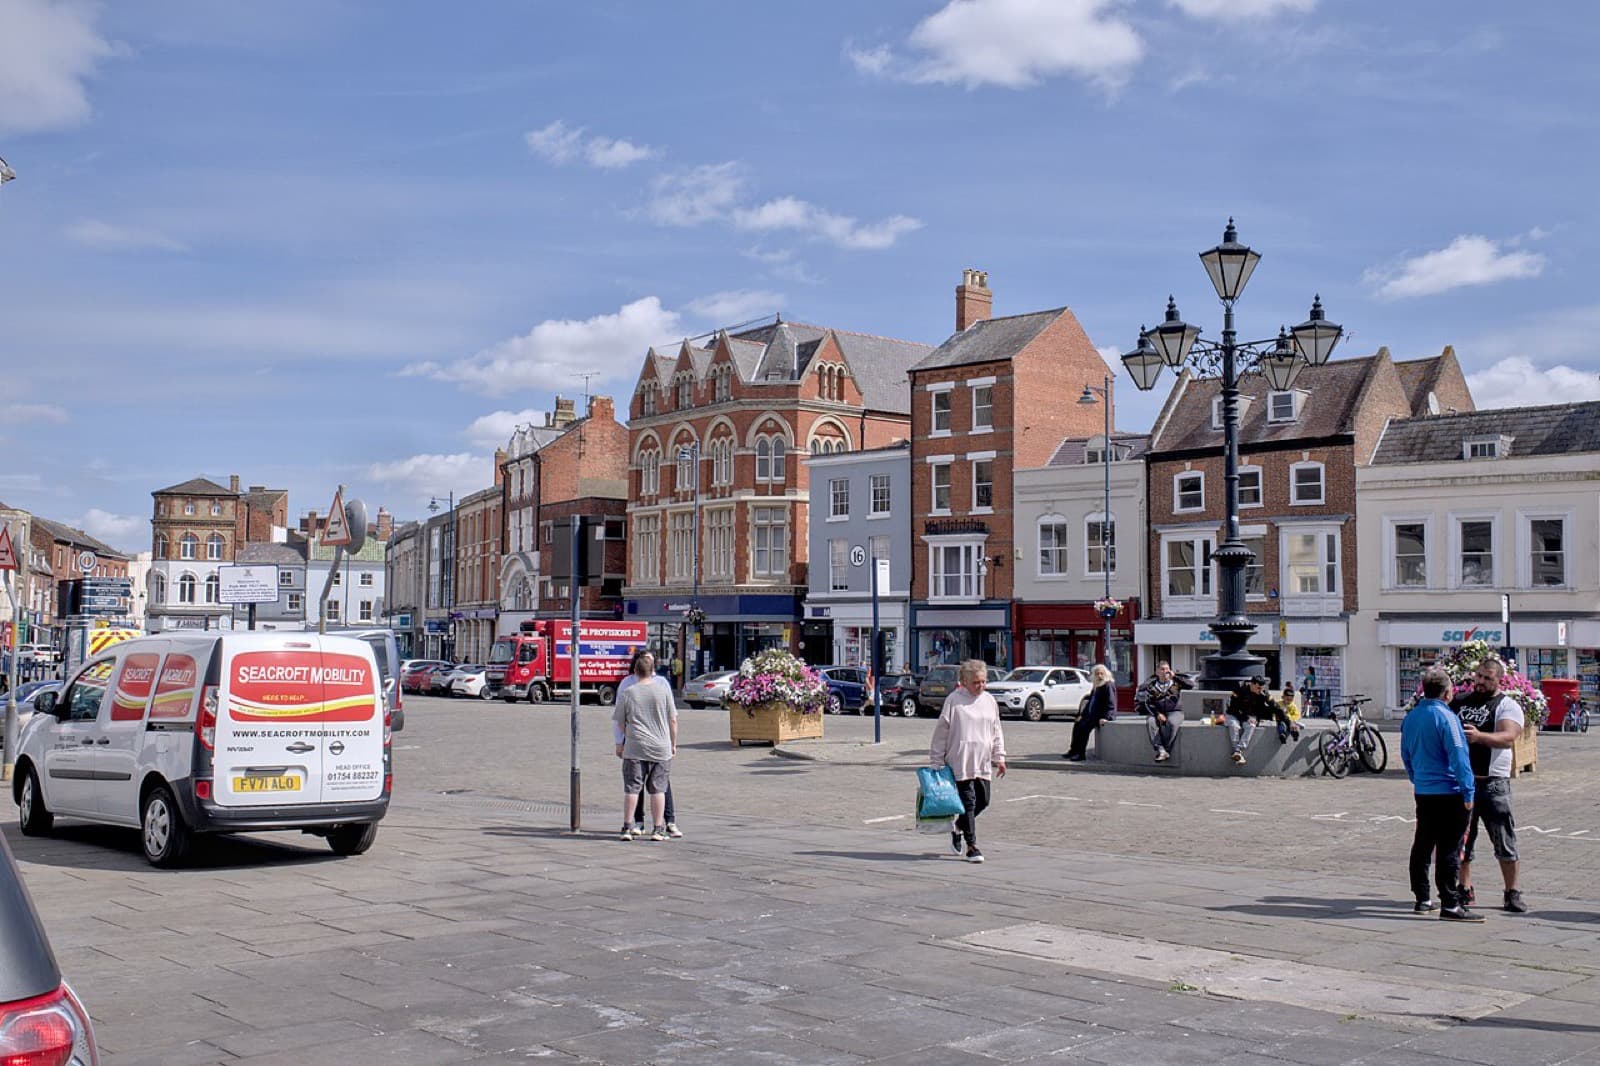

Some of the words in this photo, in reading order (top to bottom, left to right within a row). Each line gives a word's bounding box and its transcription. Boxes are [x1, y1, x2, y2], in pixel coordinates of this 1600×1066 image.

[853, 550, 864, 563] 16
[1442, 627, 1501, 641] savers
[238, 666, 309, 684] SEACROFT
[310, 668, 366, 685] MOBILITY
[232, 730, 370, 738] WWW.SEACROFTMOBILITY.COM
[240, 780, 269, 790] FV71
[271, 778, 294, 789] ALO
